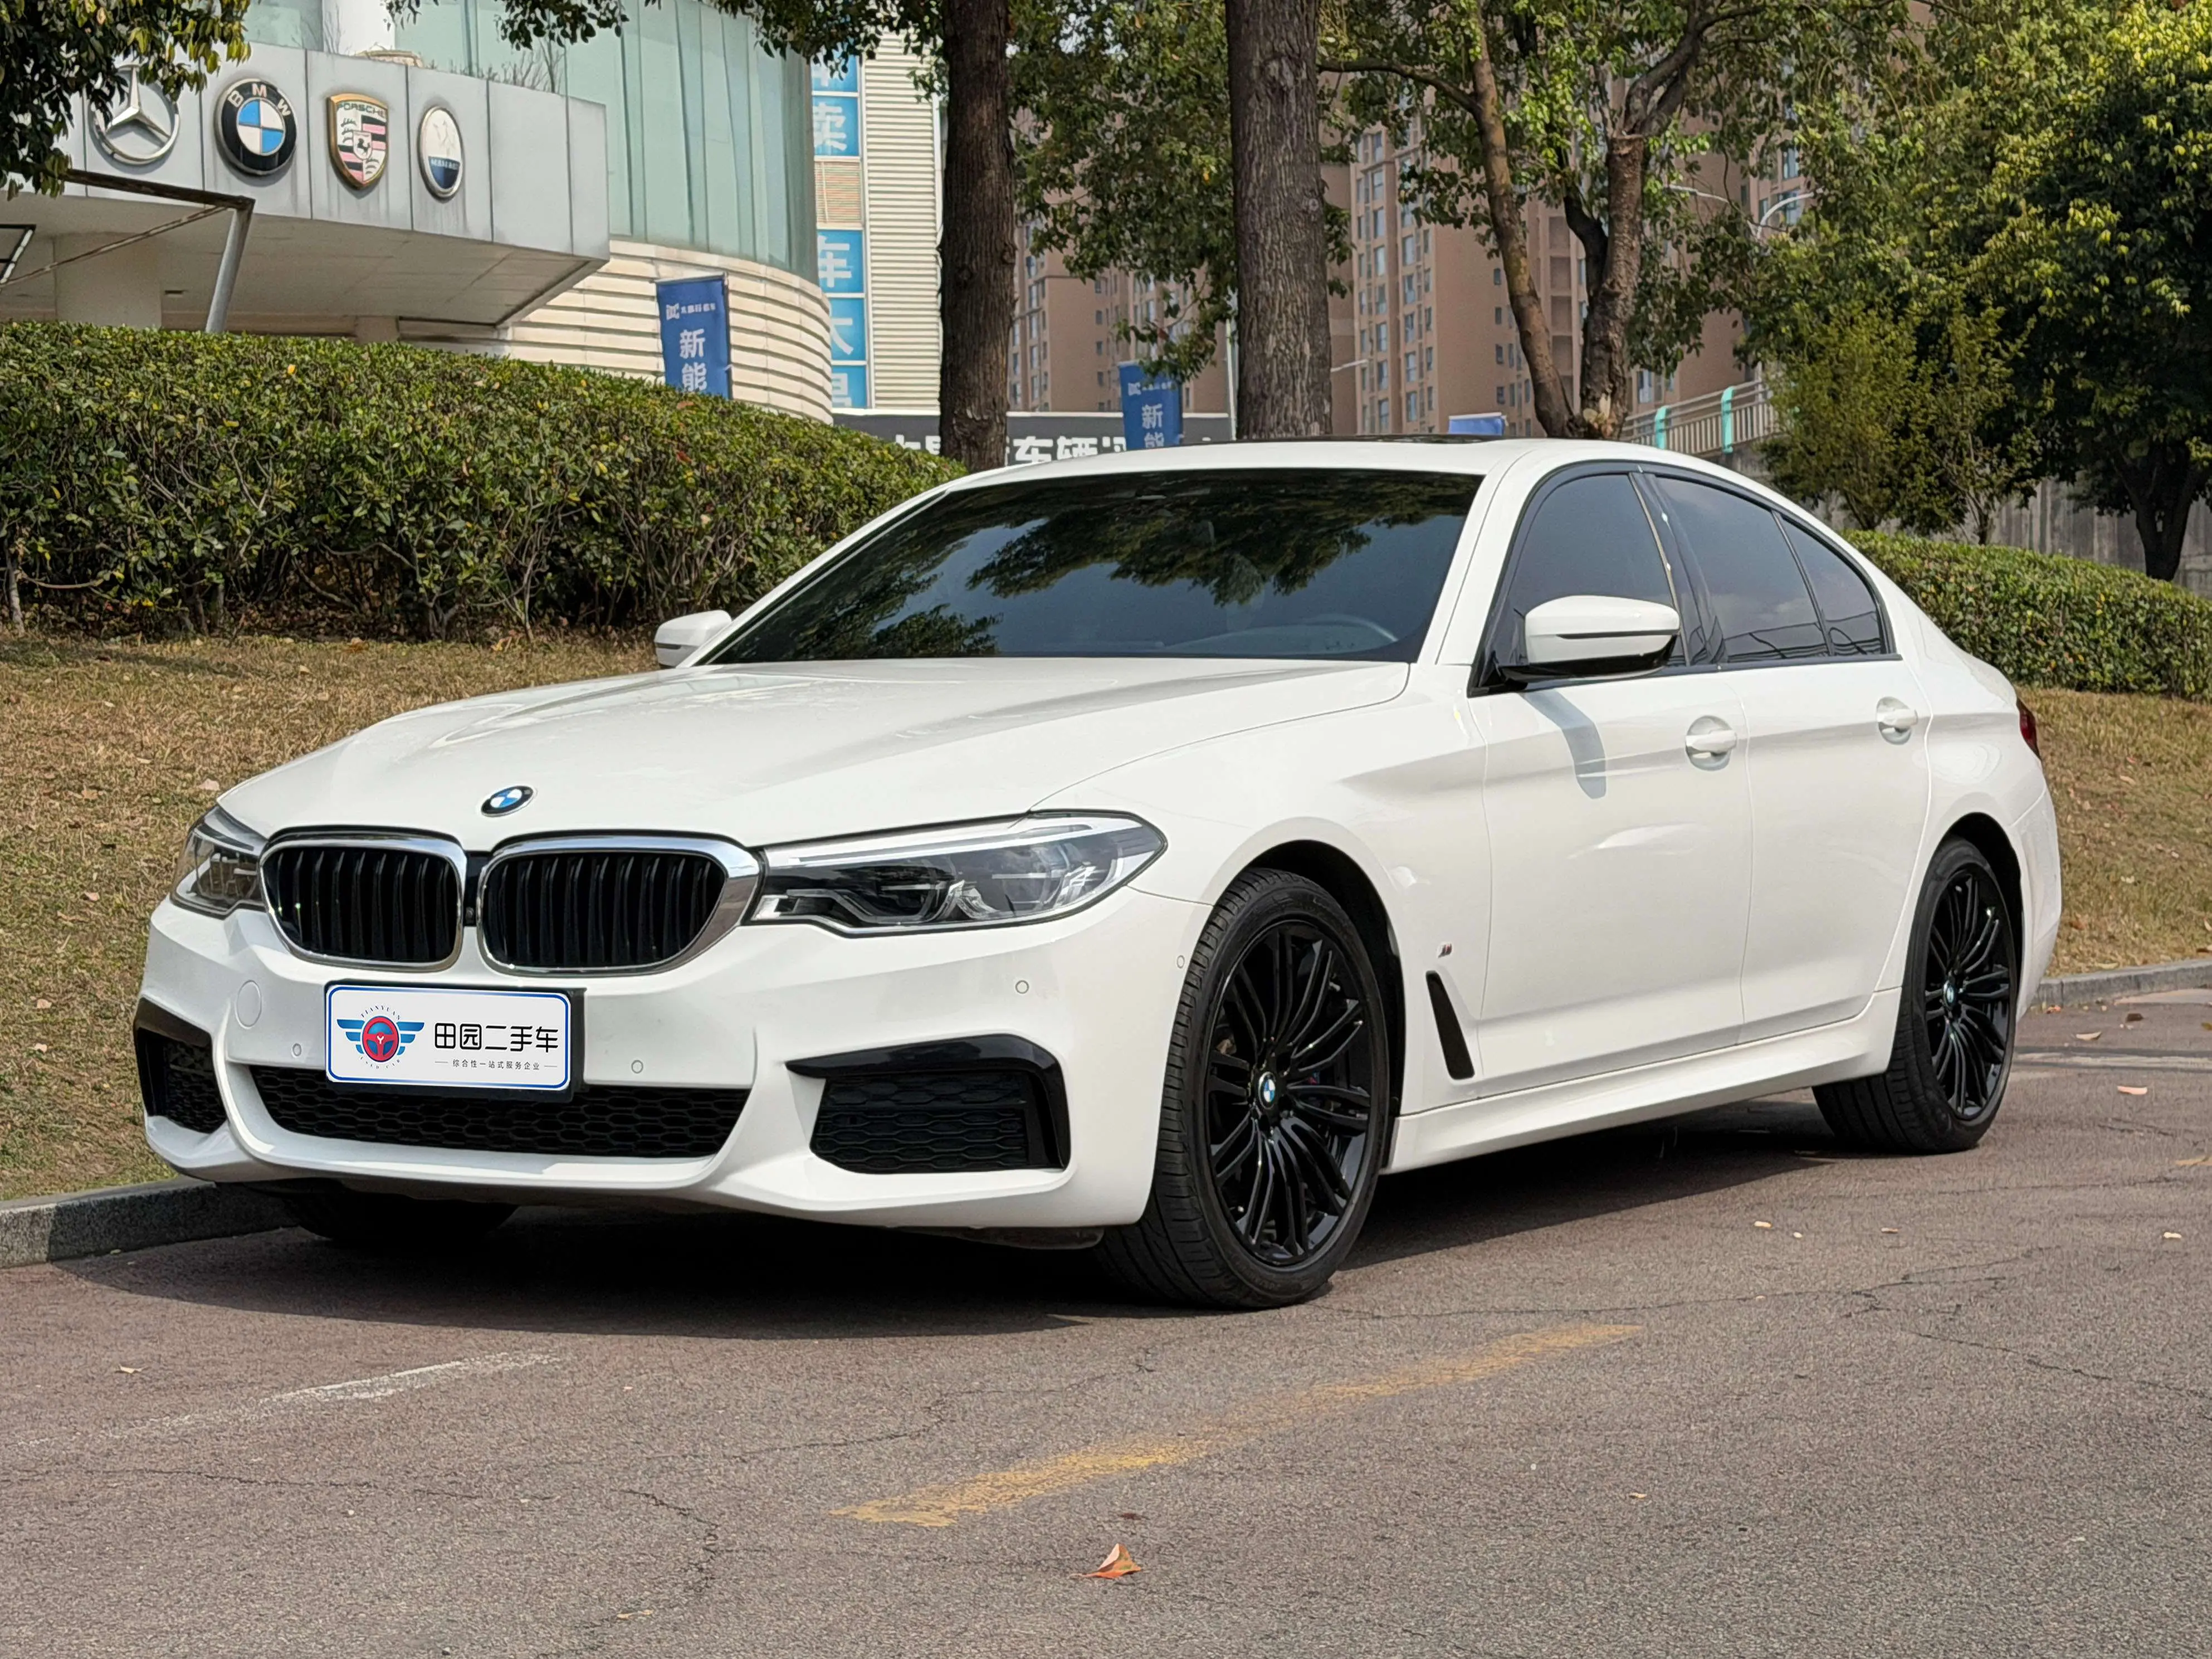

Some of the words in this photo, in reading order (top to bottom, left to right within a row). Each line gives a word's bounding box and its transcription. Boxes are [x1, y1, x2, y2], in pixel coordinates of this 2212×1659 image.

[227, 83, 291, 116] BMW
[434, 1022, 559, 1053] 田园二手车
[452, 1058, 540, 1070] 综合性一站式服务企业
